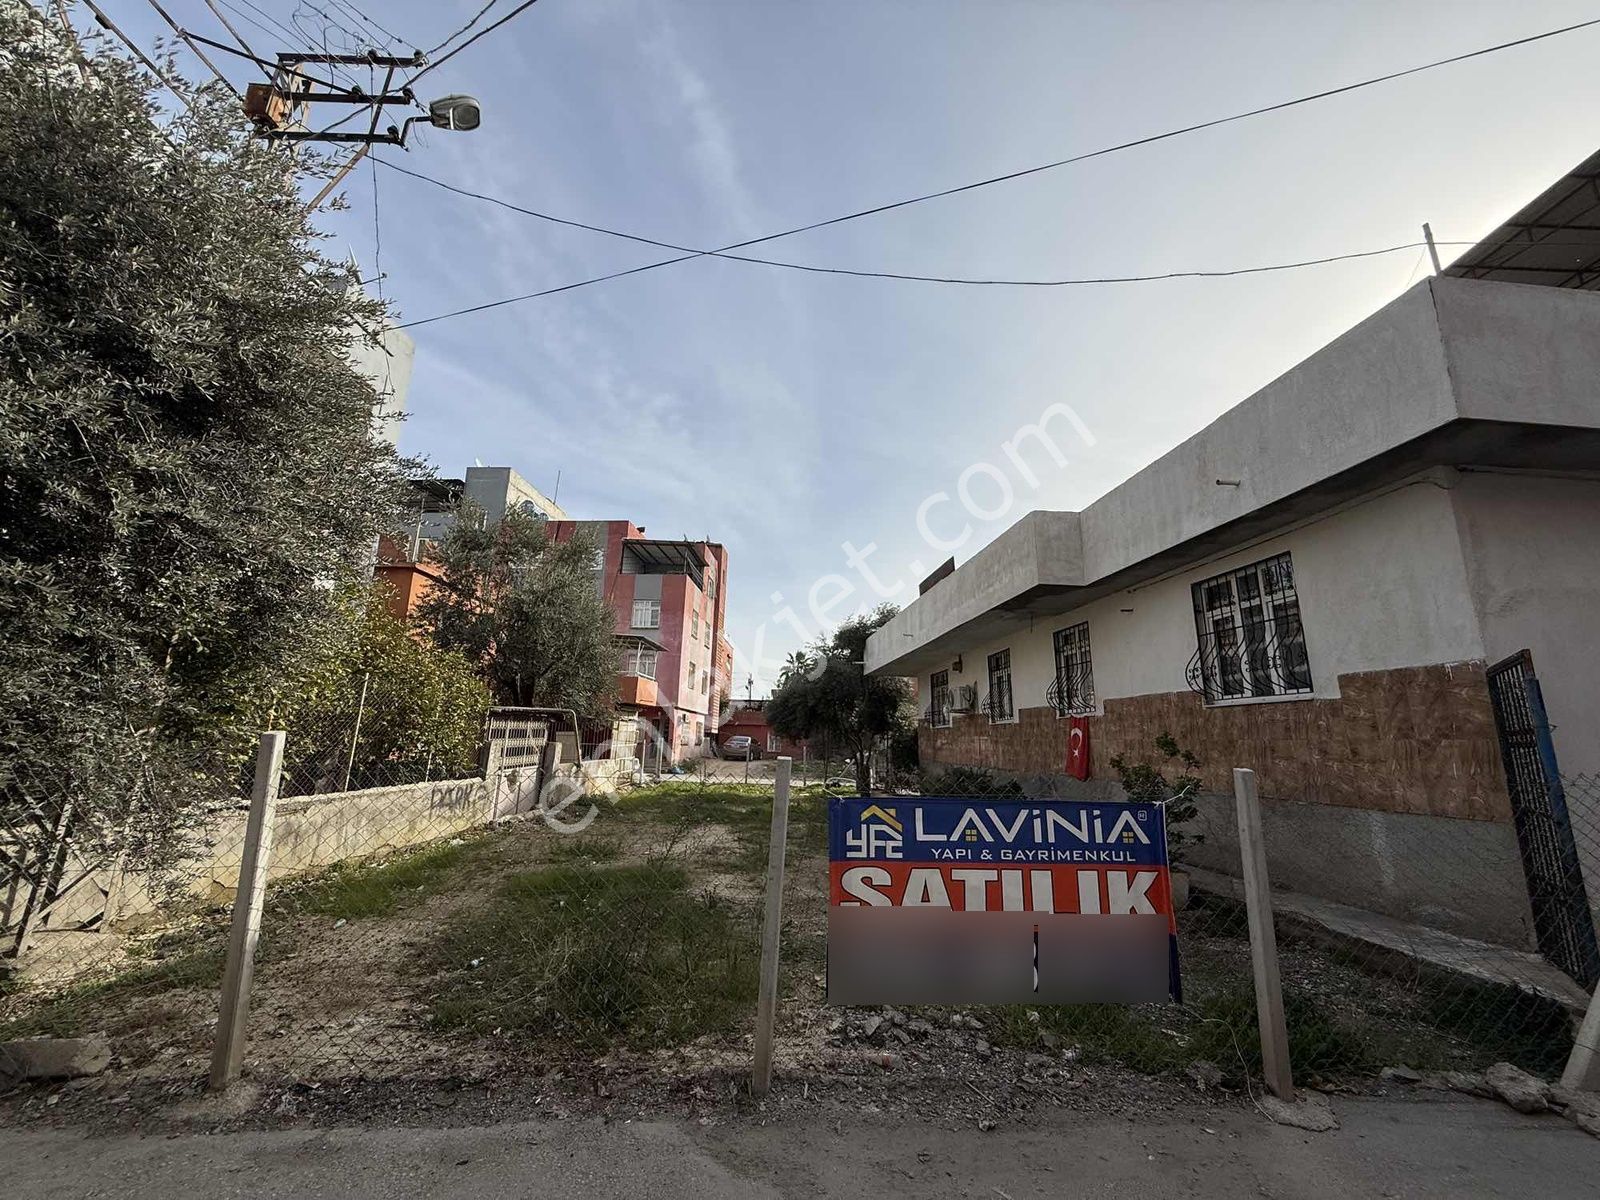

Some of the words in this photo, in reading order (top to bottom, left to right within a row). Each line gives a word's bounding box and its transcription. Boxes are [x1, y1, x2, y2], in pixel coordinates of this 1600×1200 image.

[931, 848, 972, 860] YAPI
[980, 849, 993, 860] &
[1000, 846, 1137, 862] GAYRİMENKUL
